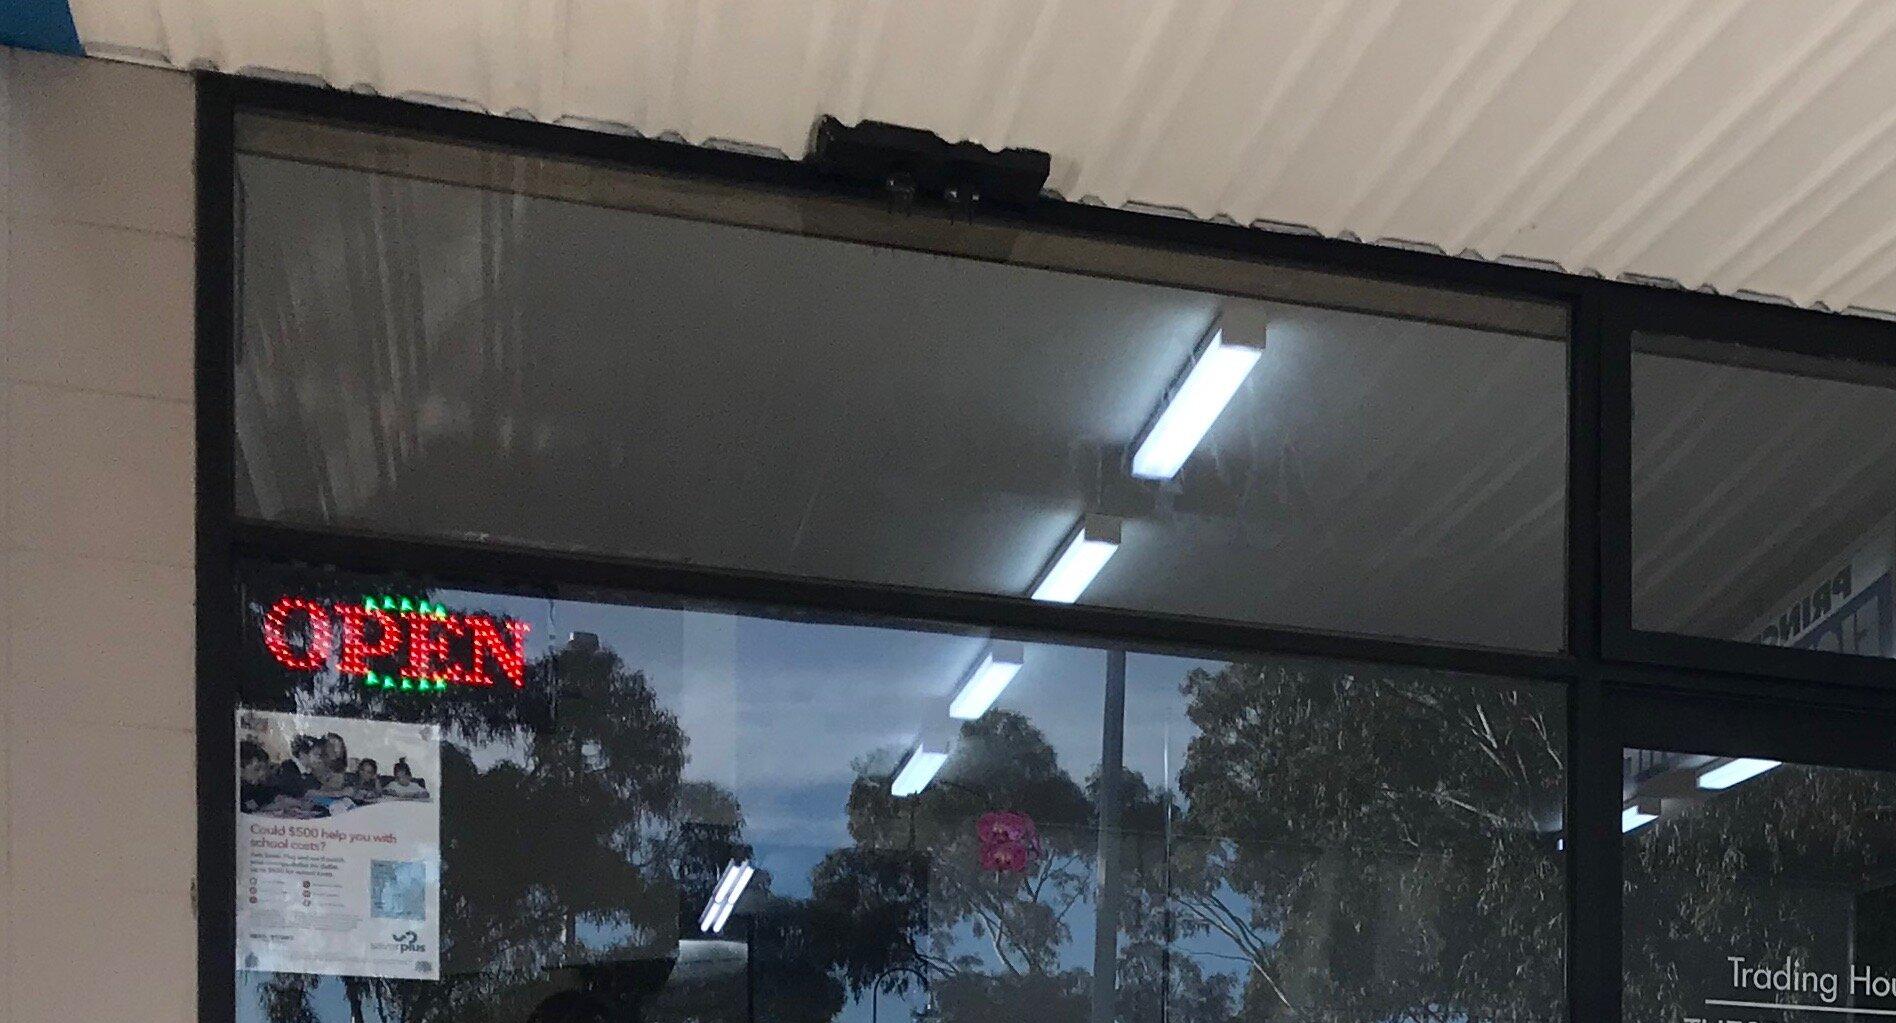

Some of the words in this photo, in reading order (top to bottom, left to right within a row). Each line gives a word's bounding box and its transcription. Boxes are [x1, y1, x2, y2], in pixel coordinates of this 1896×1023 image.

[263, 596, 533, 689] OPEN
[250, 822, 286, 836] Could
[288, 826, 319, 838] $500
[321, 828, 347, 841] help
[349, 834, 371, 844] you
[373, 832, 397, 844] with
[250, 837, 288, 849] school
[400, 943, 426, 954] plus
[1726, 955, 1838, 1004] Trading
